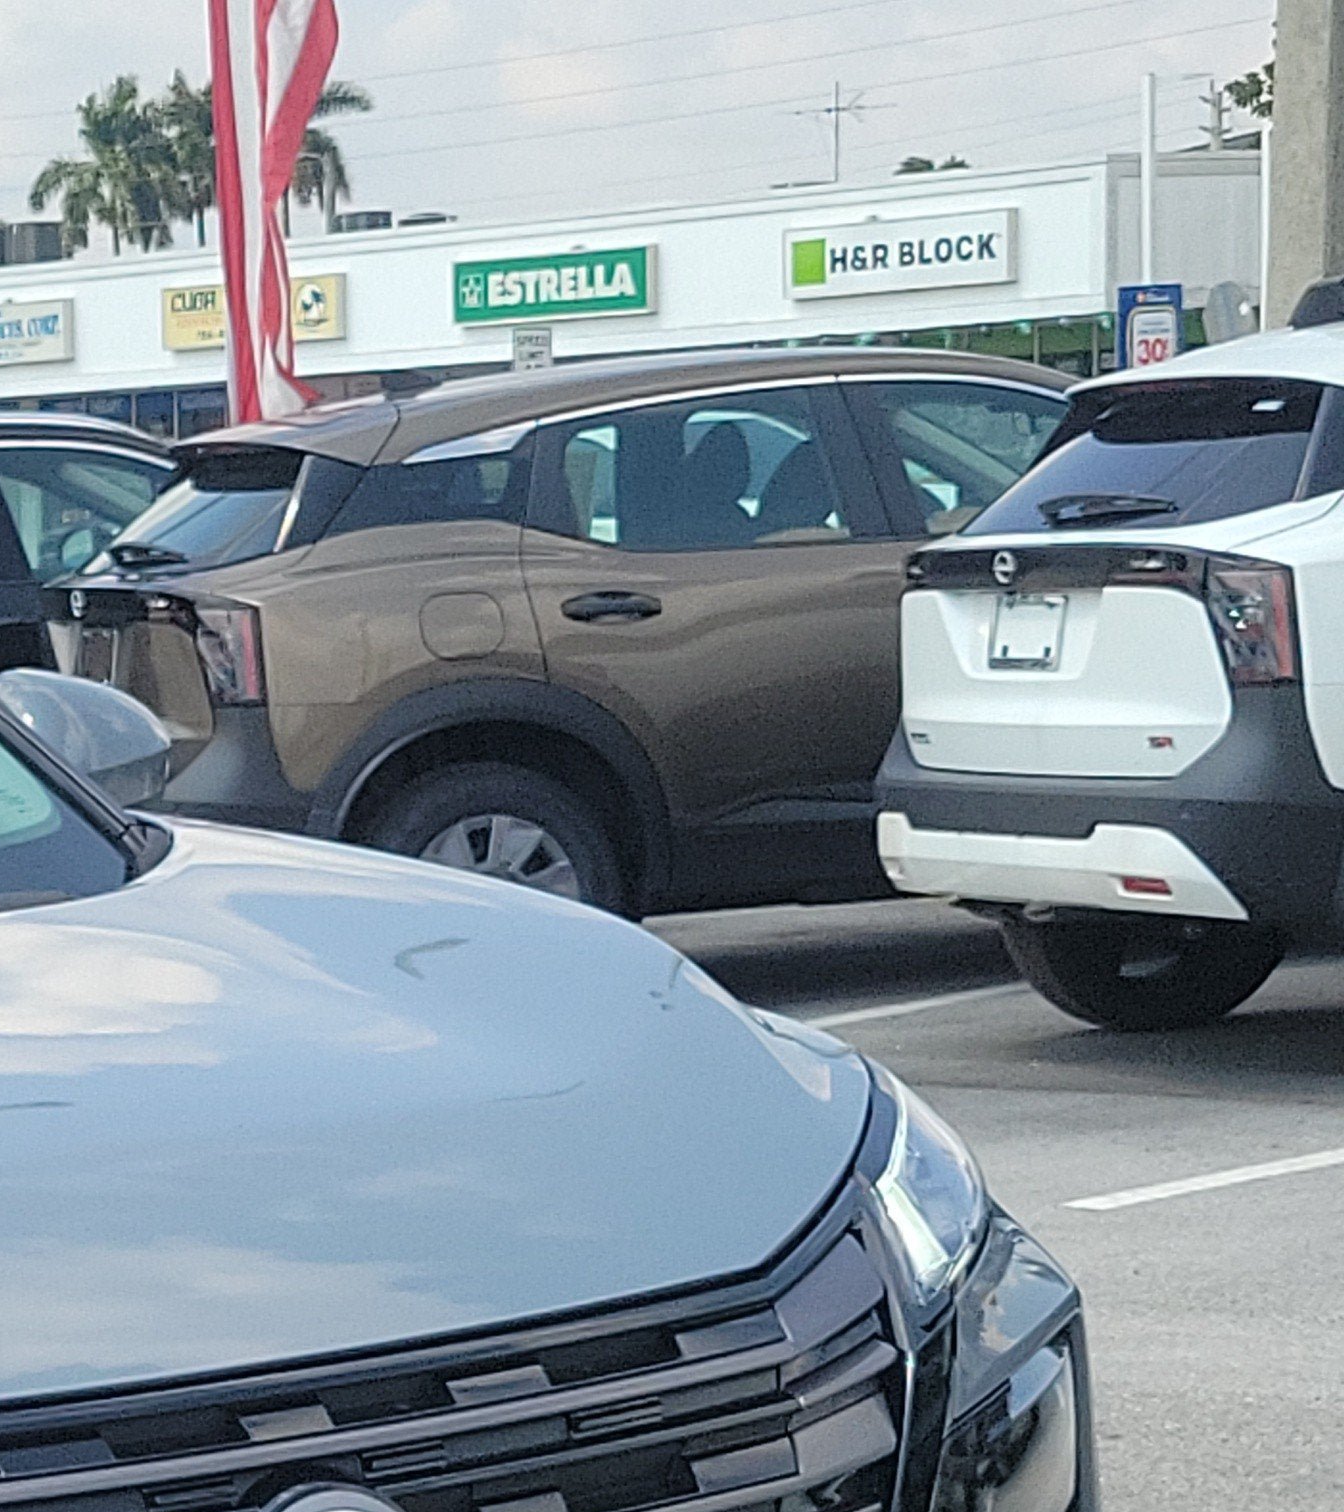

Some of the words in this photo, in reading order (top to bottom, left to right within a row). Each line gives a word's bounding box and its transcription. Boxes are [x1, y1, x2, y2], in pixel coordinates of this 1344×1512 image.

[829, 243, 890, 273] H&R
[897, 232, 997, 267] BLOCK
[170, 289, 217, 312] CUBA
[485, 262, 638, 308] ESTRELLA
